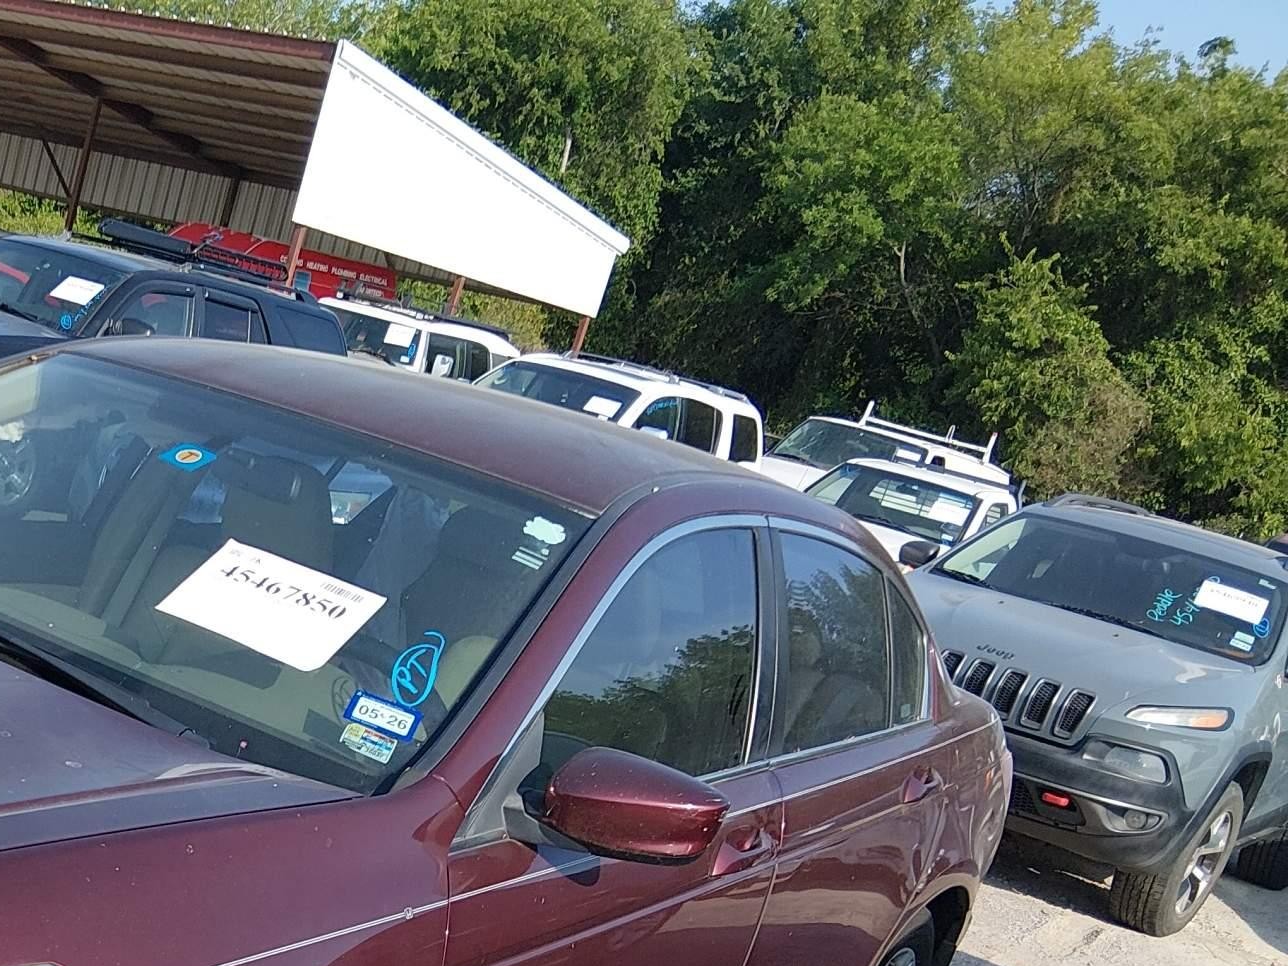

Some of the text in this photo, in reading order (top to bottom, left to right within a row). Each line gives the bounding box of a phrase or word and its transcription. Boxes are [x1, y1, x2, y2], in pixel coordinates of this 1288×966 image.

[306, 261, 329, 272] HEATING
[220, 565, 347, 619] 45467850
[976, 643, 1015, 661] Jeep
